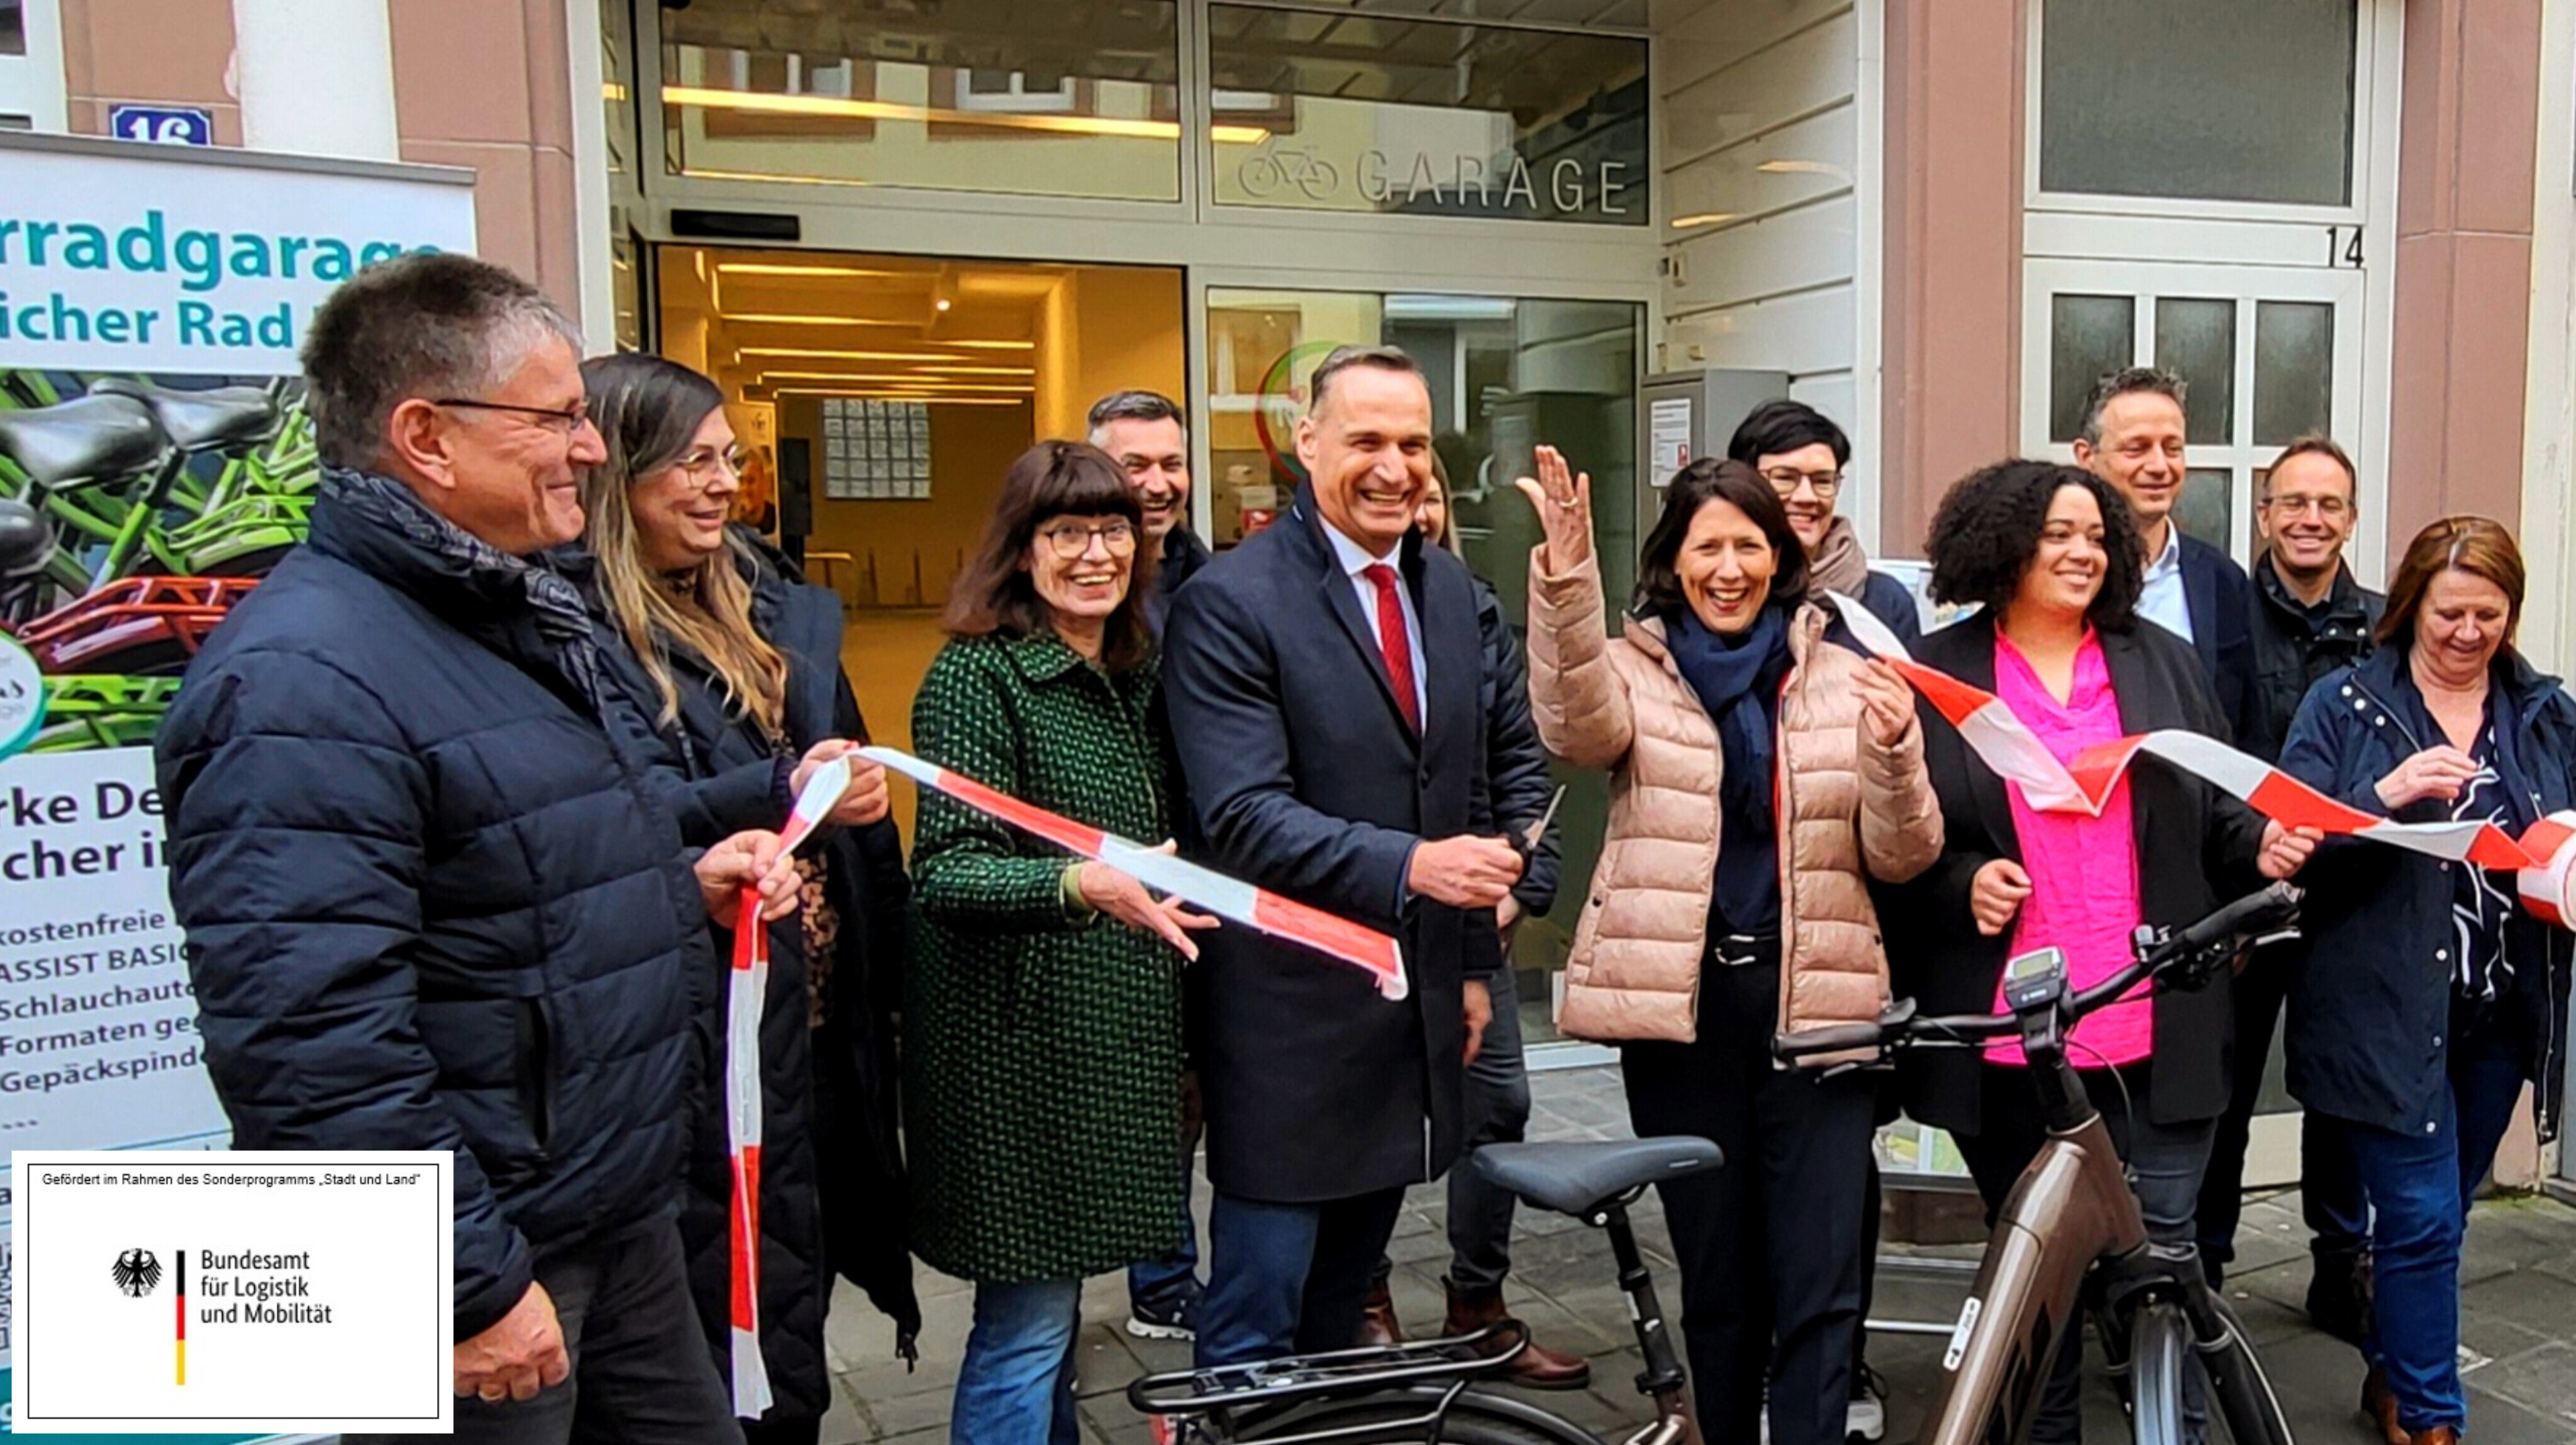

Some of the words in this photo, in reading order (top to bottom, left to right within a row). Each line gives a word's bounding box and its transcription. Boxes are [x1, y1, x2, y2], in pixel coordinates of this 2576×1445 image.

[1356, 150, 1628, 214] GARAGE
[2326, 226, 2364, 269] 14
[178, 301, 293, 347] Rad
[0, 1021, 147, 1056] Formaten
